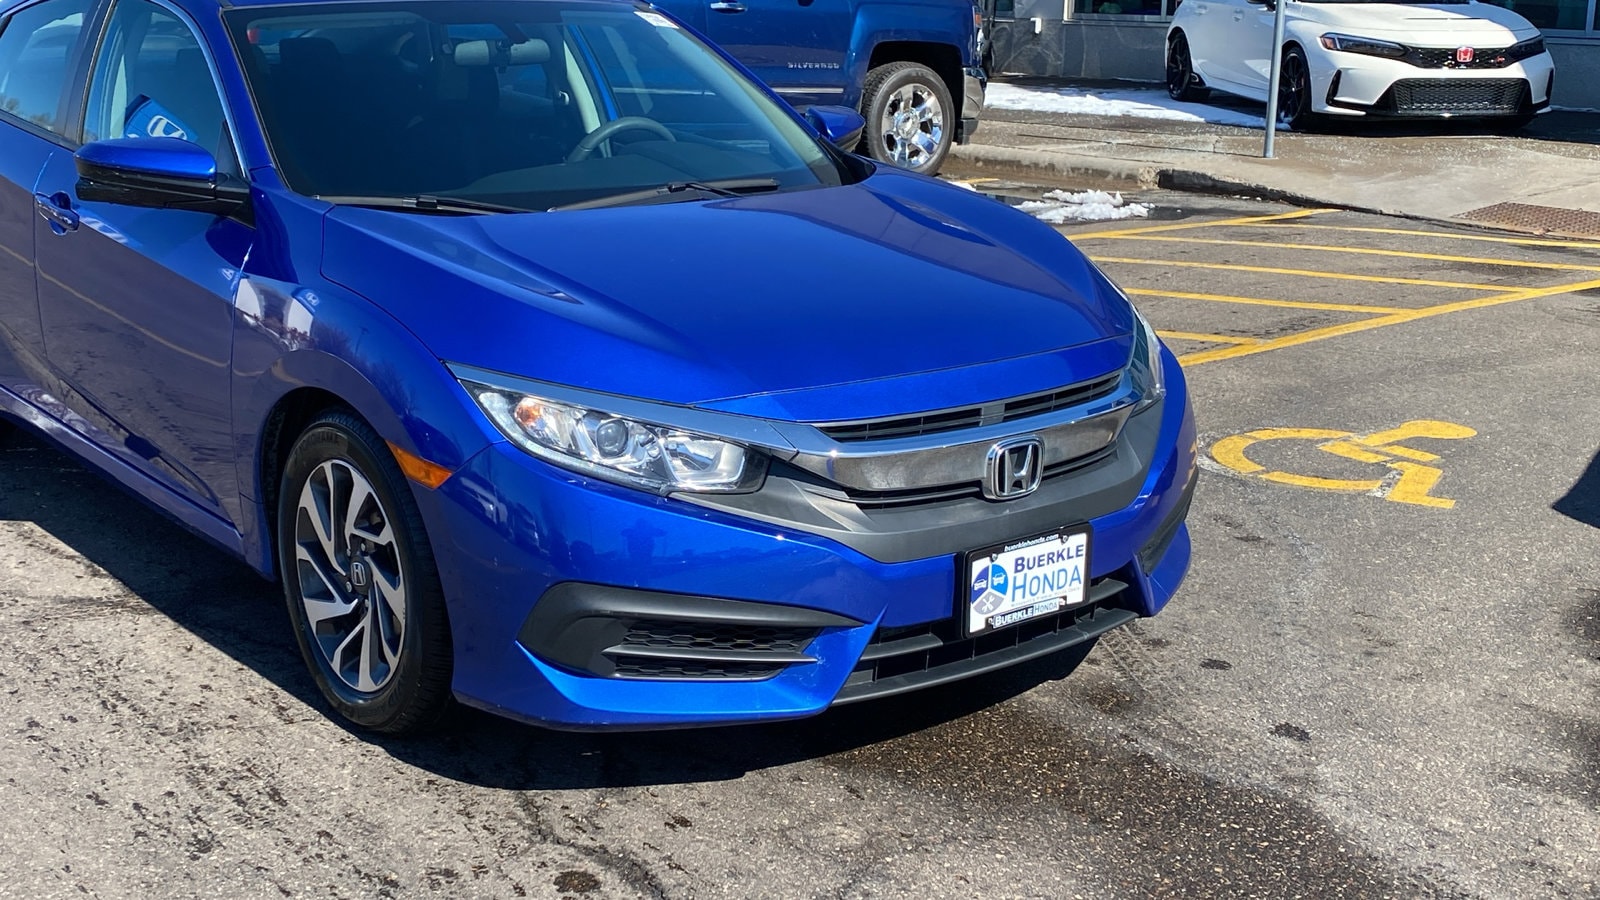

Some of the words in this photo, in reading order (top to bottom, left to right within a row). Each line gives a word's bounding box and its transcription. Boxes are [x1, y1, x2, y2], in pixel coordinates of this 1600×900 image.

[1004, 533, 1059, 552] buerklehonda.com
[1013, 544, 1085, 574] BUERKLE
[1011, 564, 1082, 602] HONDA
